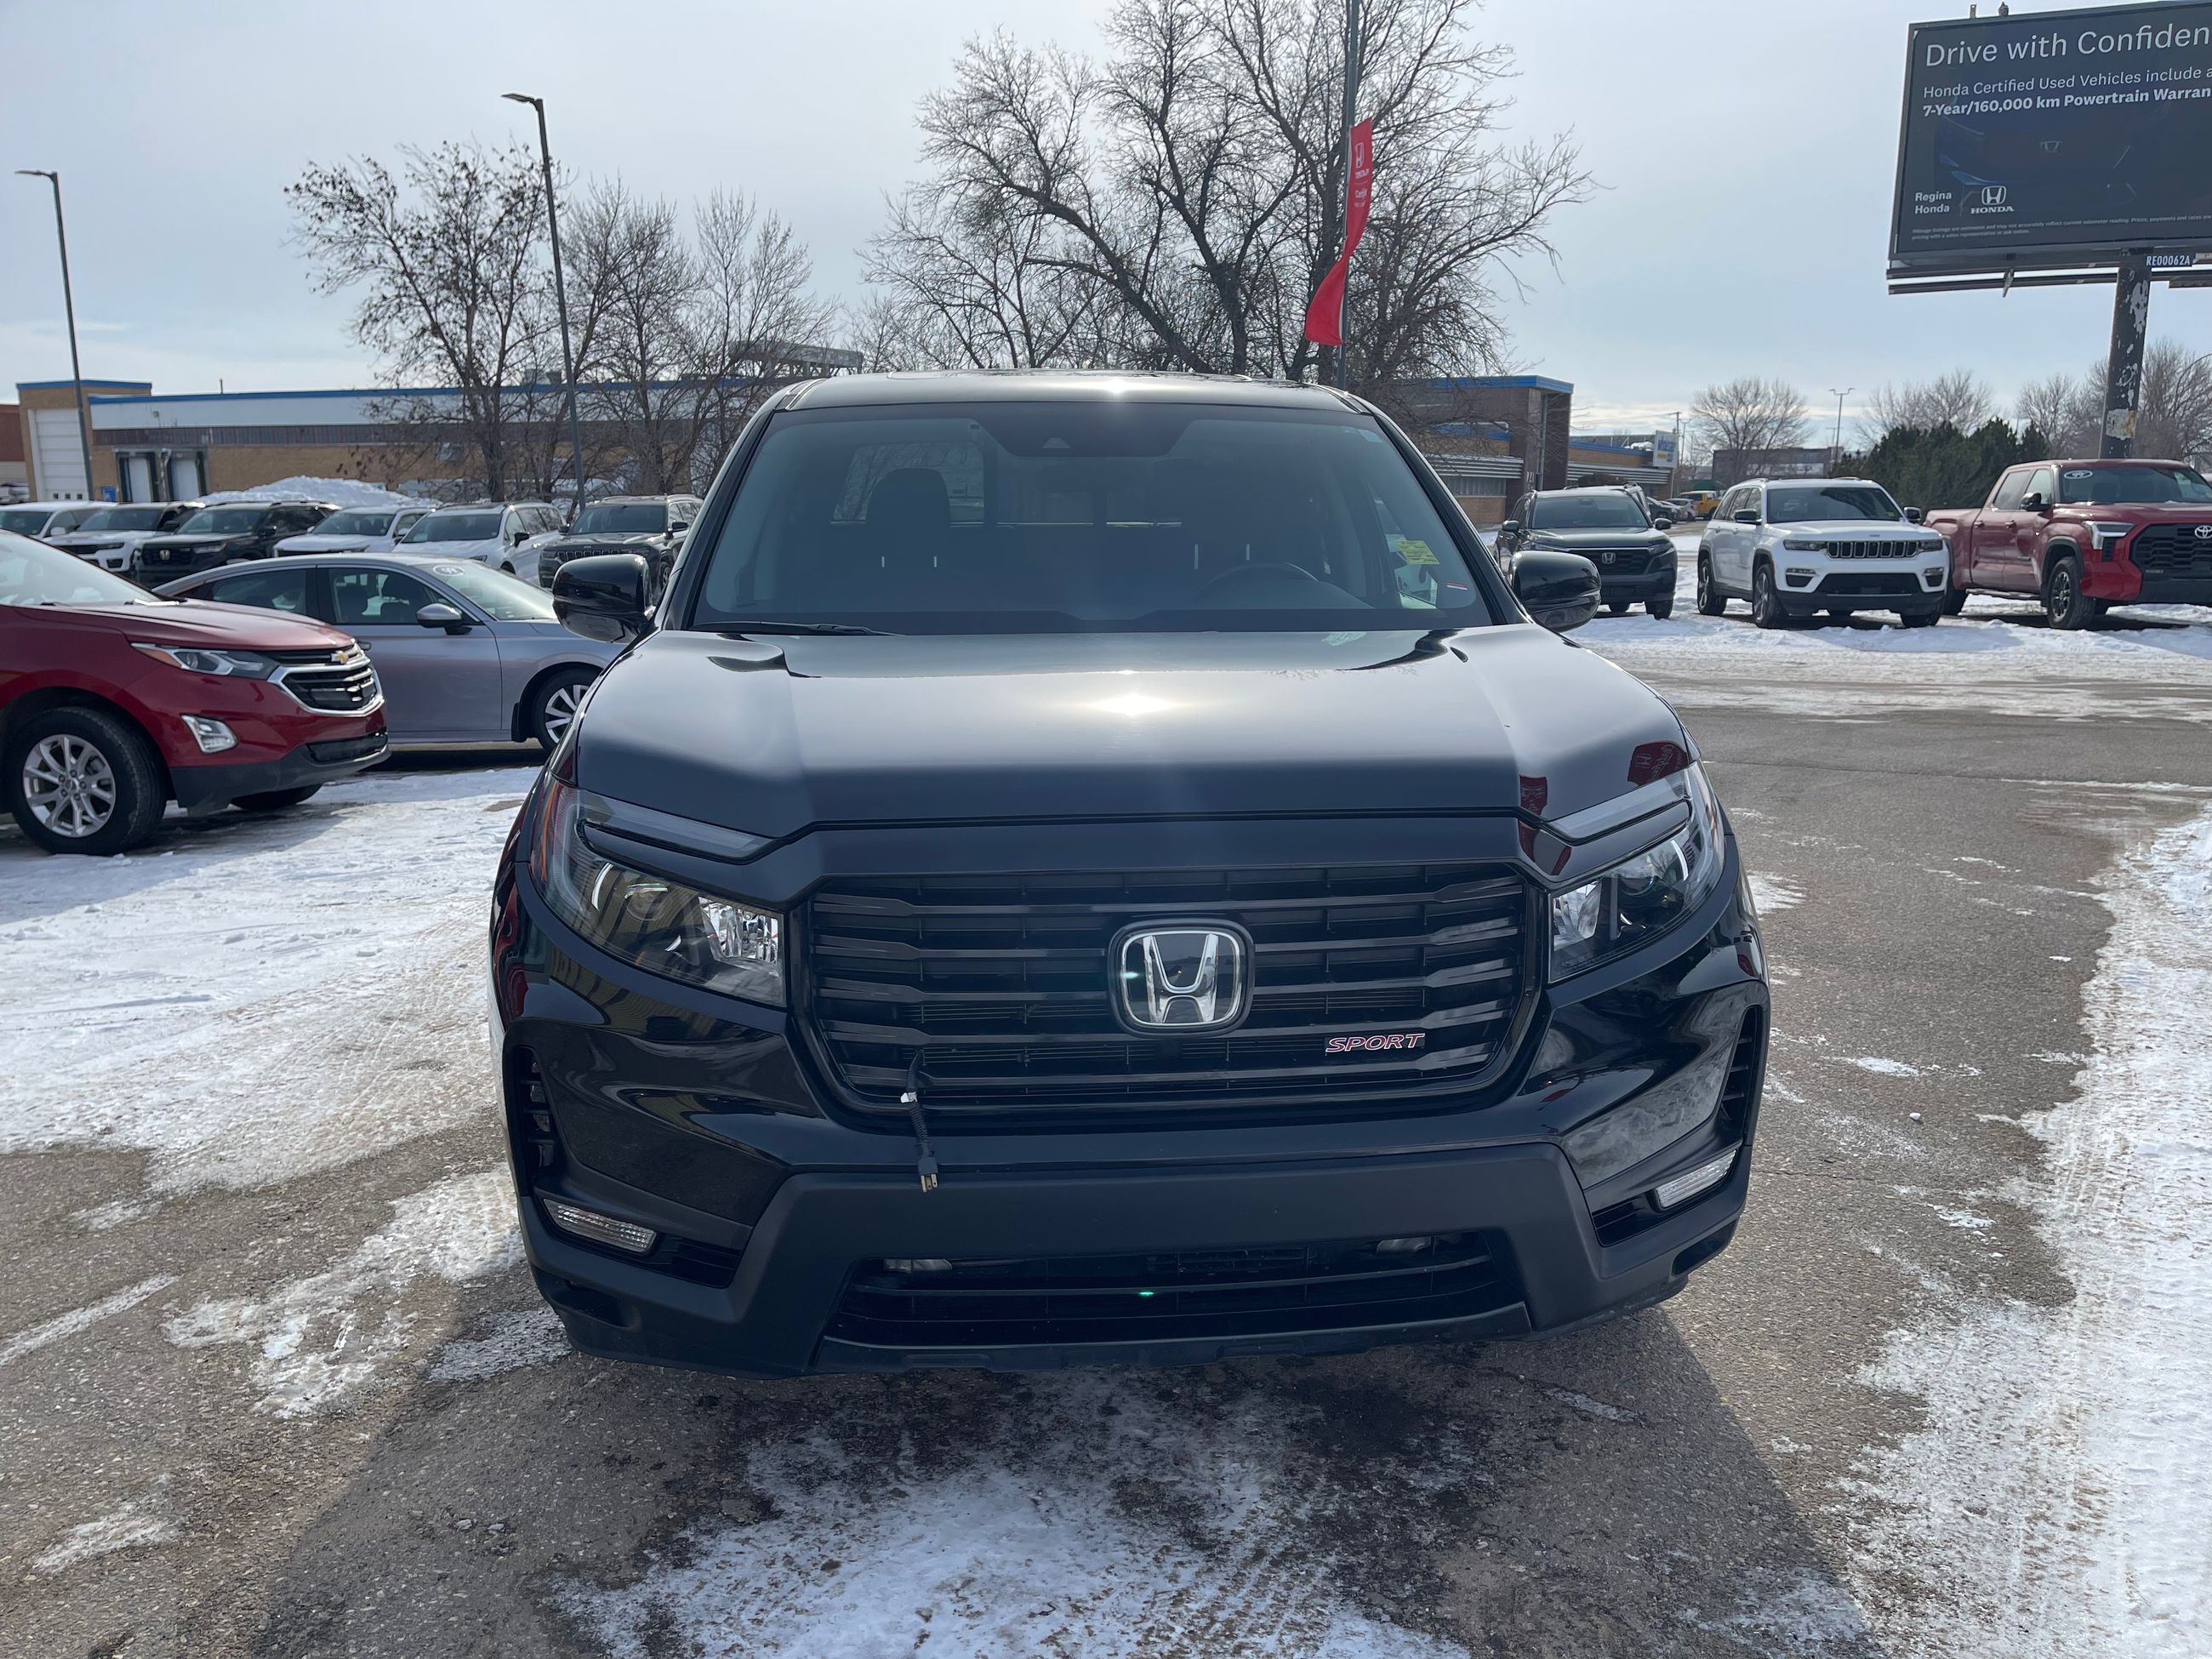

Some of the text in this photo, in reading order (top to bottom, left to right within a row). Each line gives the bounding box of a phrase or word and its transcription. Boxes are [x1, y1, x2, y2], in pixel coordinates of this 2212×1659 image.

[1926, 23, 2210, 66] Drive with Confiden
[1924, 83, 1970, 99] Honda
[1973, 77, 2035, 94] Certified
[2039, 75, 2075, 89] Used
[2080, 71, 2141, 86] Vehicles
[2146, 66, 2202, 83] include
[1923, 87, 2212, 117] 7-Year/160,000 km Powertrain Warran
[1914, 191, 1953, 203] Regina
[1914, 204, 1950, 214] Honda
[2146, 254, 2191, 266] RE00062A
[1325, 1032, 1426, 1052] SPORT
